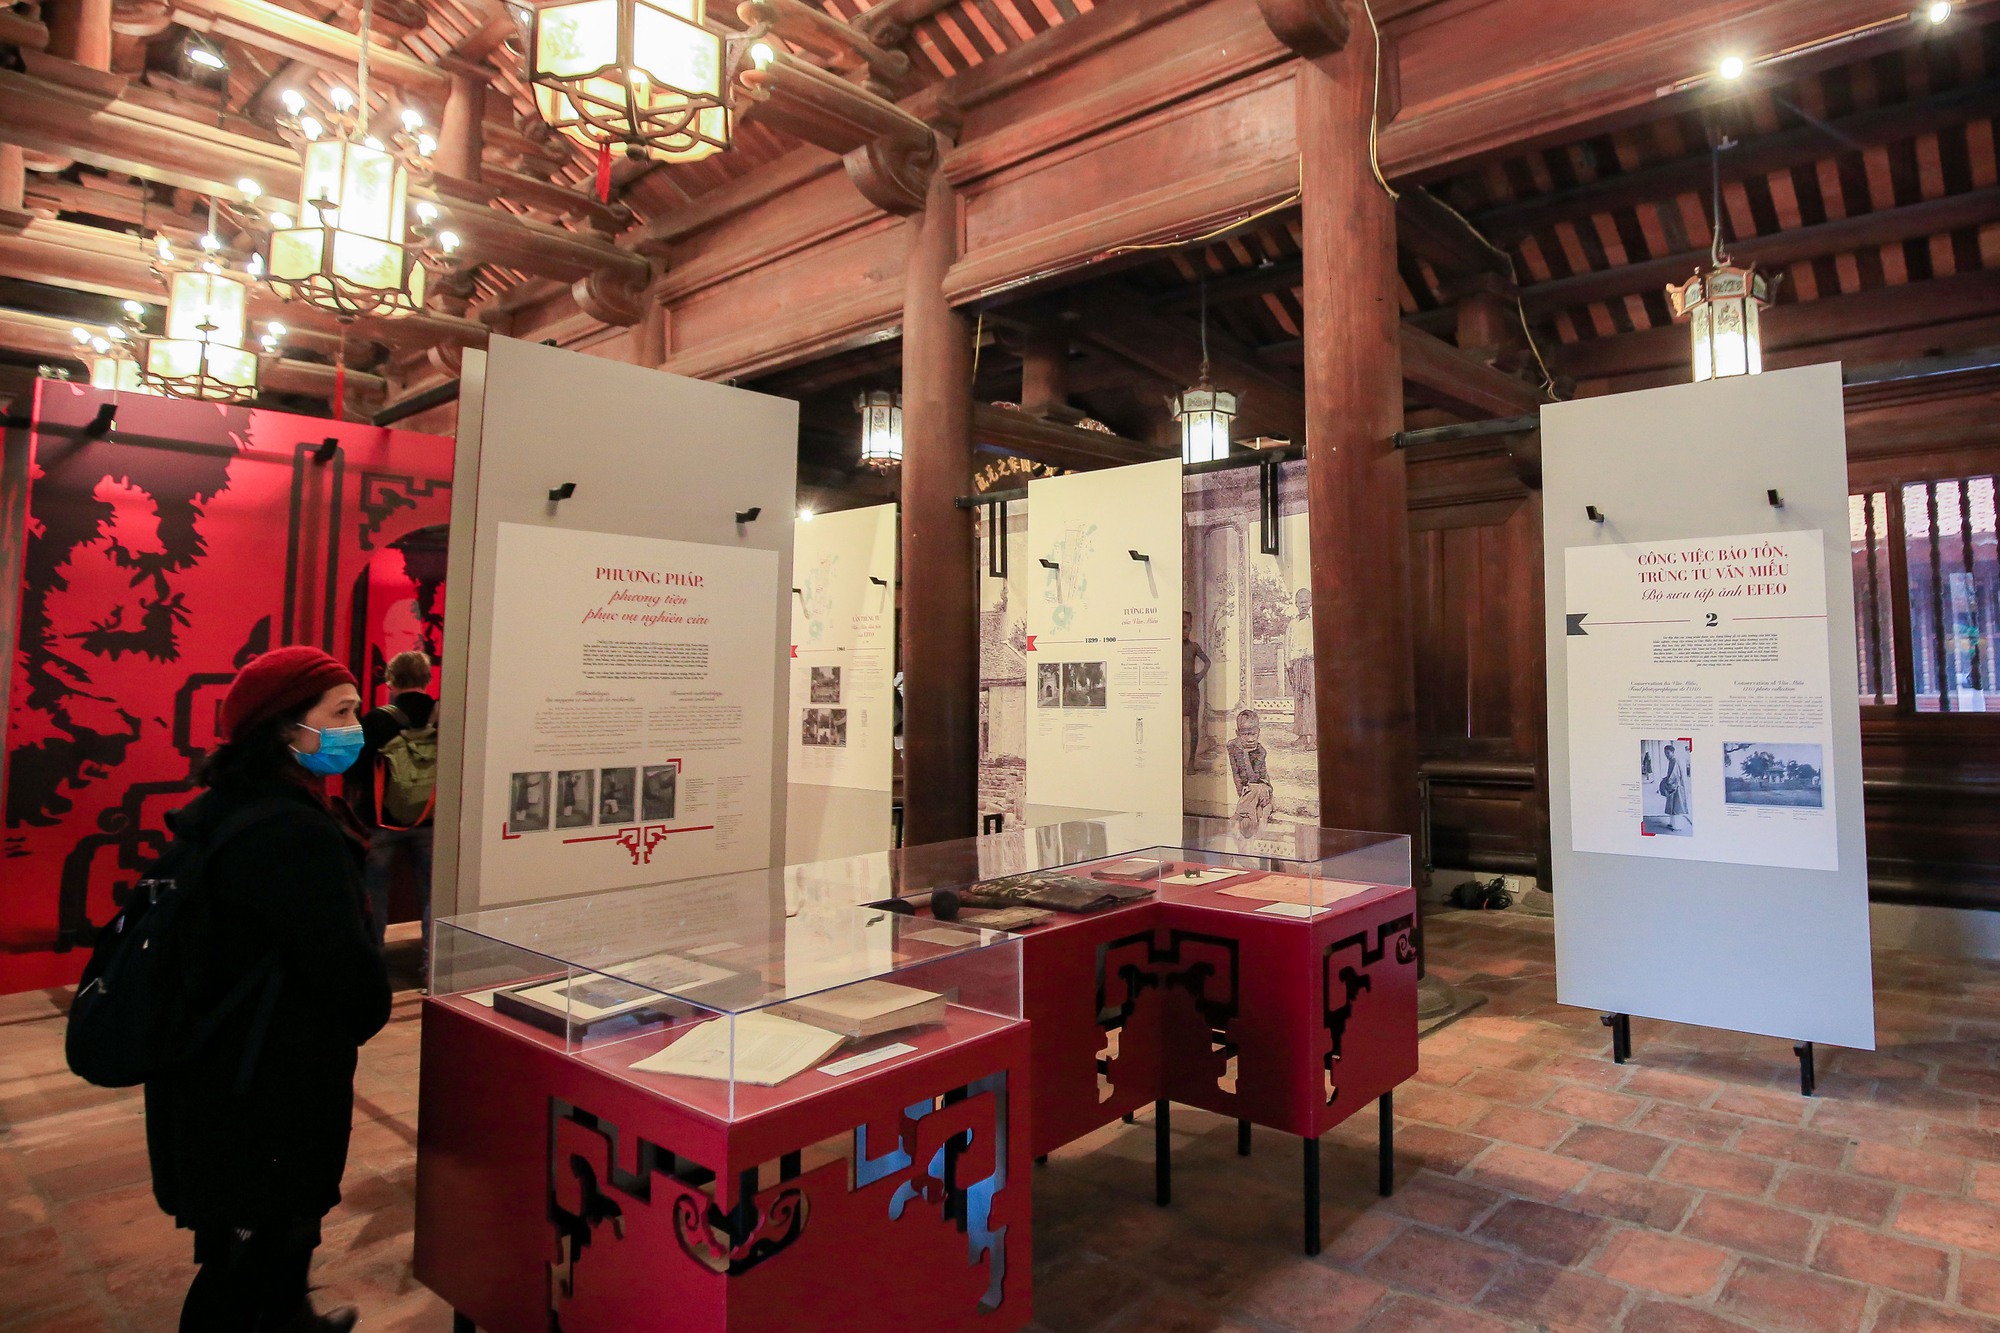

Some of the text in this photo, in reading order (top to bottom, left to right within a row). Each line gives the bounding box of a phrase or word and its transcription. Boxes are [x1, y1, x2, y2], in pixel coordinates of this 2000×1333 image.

[1638, 540, 1788, 566] CÔNG VIỆC BẢO TỒN,
[596, 567, 661, 584] PHƯƠNG
[1638, 559, 1790, 583] TRÙNG TU VĂN MIẾU
[608, 588, 688, 608] phương tiện
[1642, 588, 1663, 602] Bộ
[1694, 588, 1714, 602] tập
[1718, 584, 1744, 598] ảnh
[1747, 582, 1787, 596] EFEO
[582, 607, 709, 627] phục vụ nghiên cứu
[1705, 612, 1718, 628] 2
